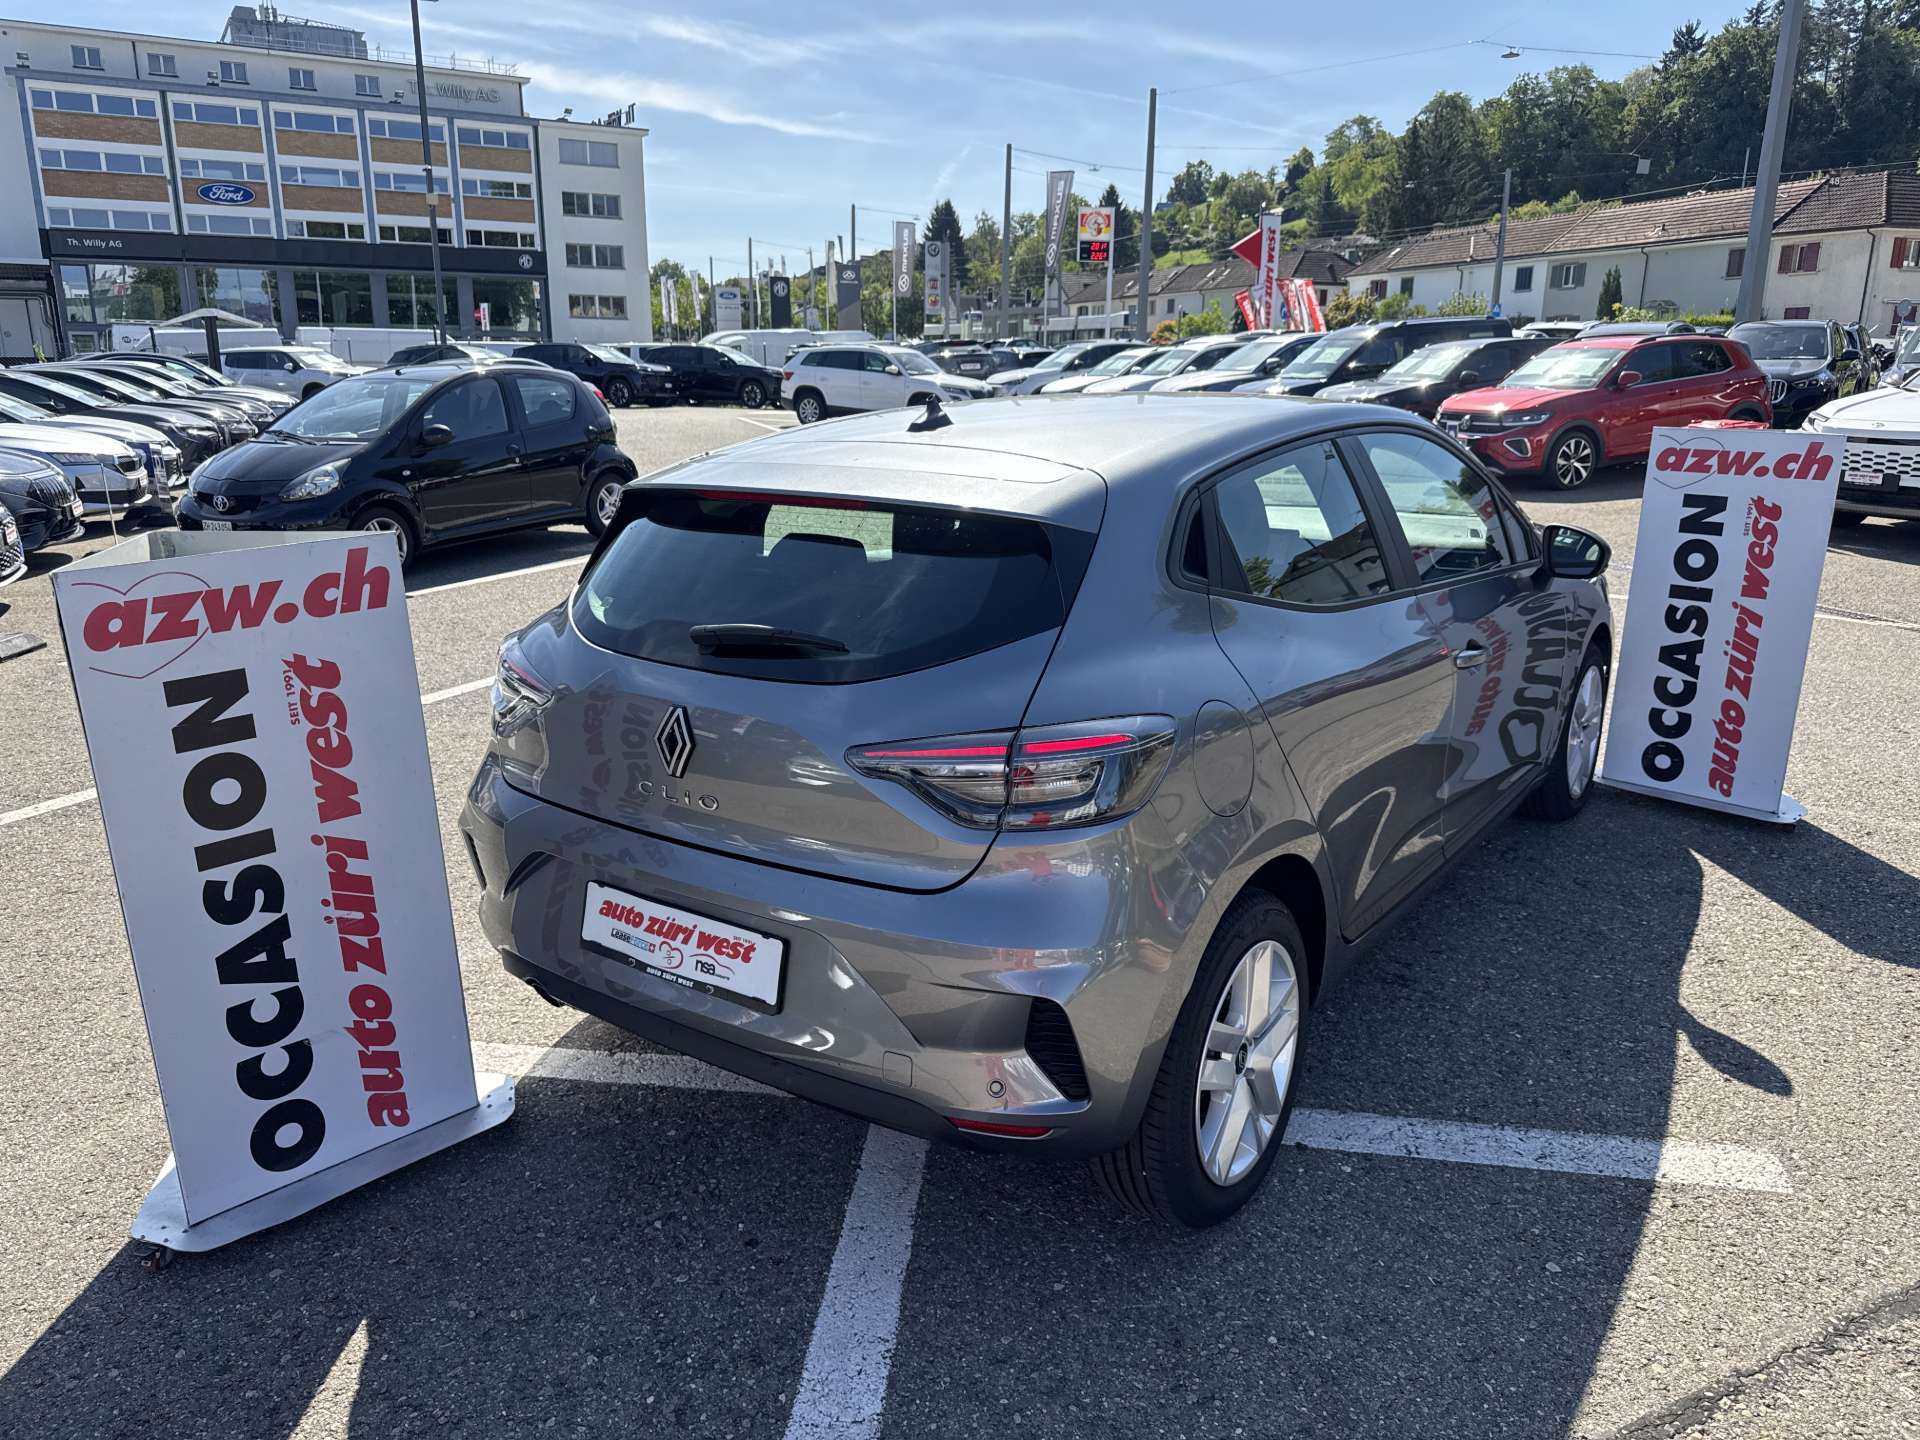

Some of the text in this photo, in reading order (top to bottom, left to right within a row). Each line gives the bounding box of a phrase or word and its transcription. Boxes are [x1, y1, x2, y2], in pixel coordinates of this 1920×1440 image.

[435, 82, 472, 104] Willy
[475, 87, 500, 103] AG
[209, 184, 244, 201] Ford
[66, 238, 123, 249] Th. Willy AG
[1655, 441, 1834, 481] azw.ch
[1743, 522, 1751, 536] SEIT
[83, 546, 390, 652] azw.ch
[1640, 493, 1728, 783] OCCASION
[1708, 496, 1783, 797] auto züri west
[283, 669, 300, 726] SEIT 1991
[638, 780, 719, 811] CLIO
[282, 653, 410, 1128] auto züri west
[163, 668, 326, 1172] OCCASION
[599, 900, 757, 964] auto züri west
[646, 967, 694, 988] auto züri west
[695, 959, 716, 976] nsa
